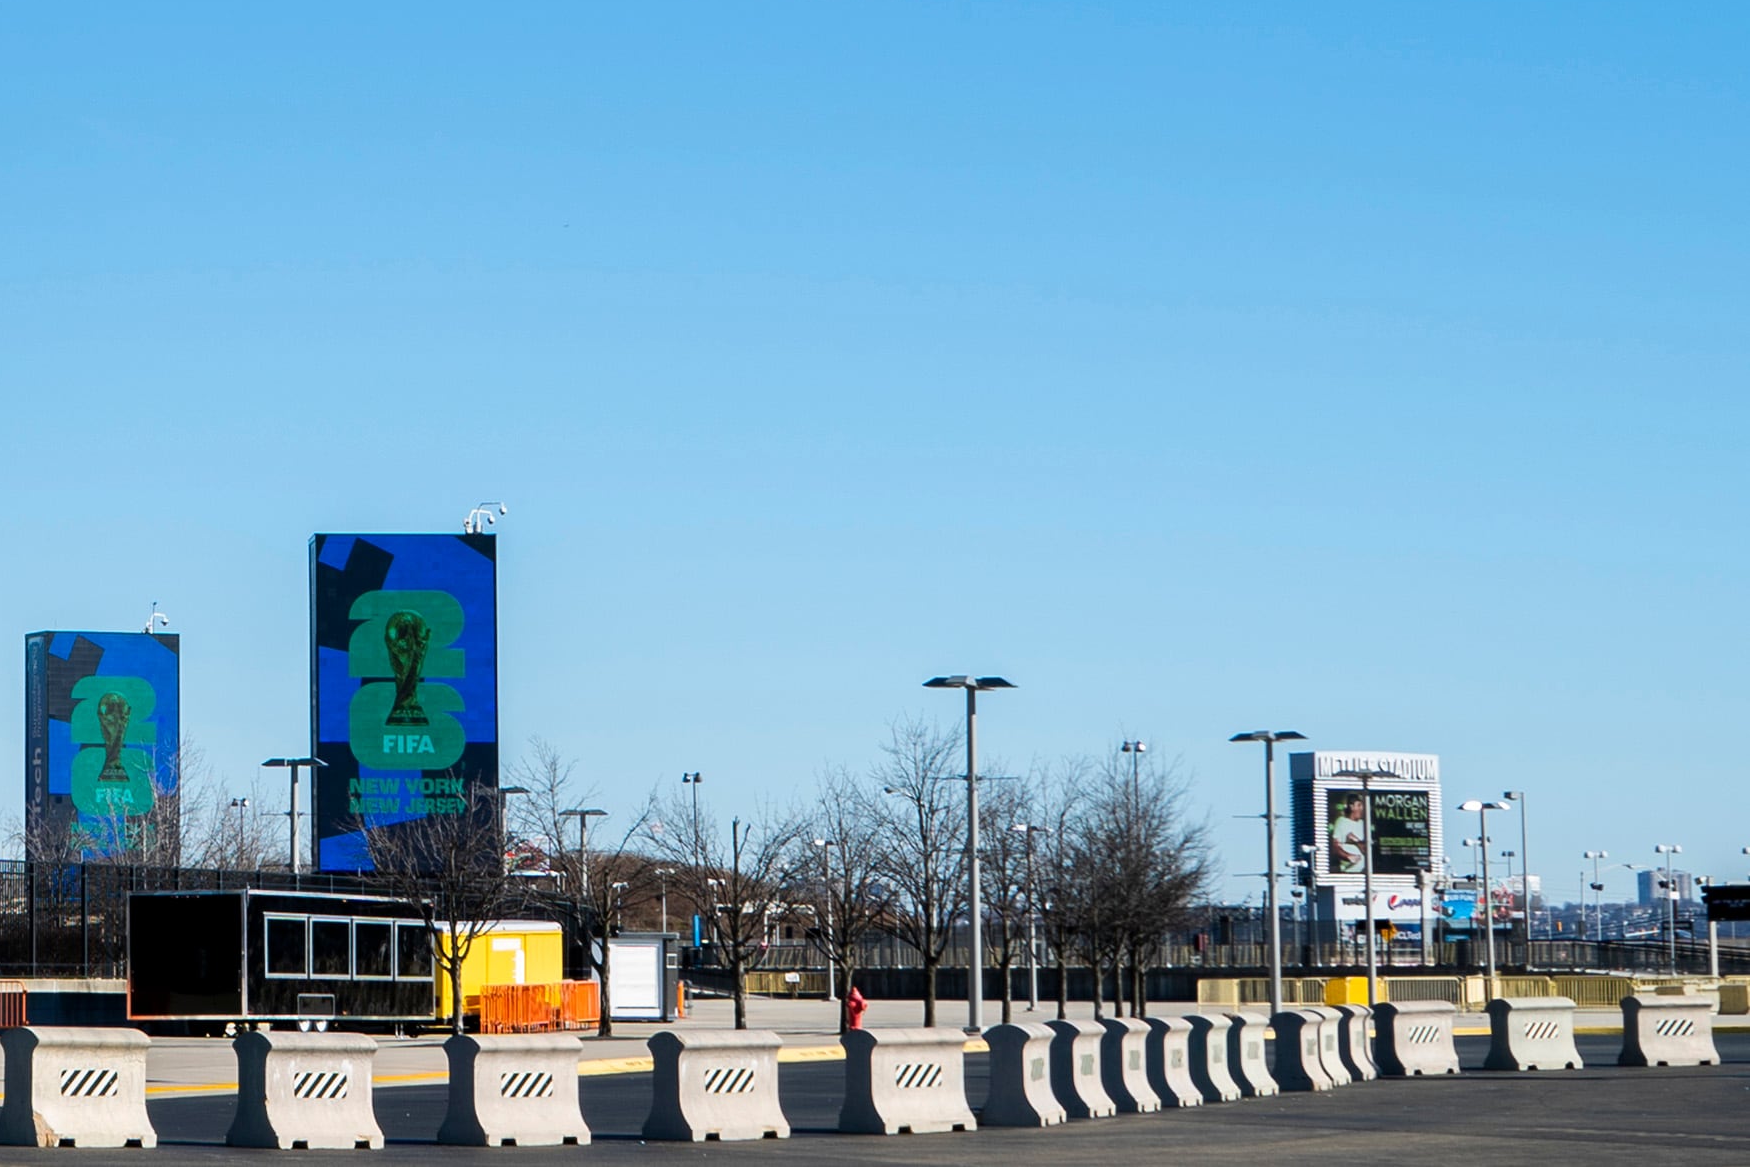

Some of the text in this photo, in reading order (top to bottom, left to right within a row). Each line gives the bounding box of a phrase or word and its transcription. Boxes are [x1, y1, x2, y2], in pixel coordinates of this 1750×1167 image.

[383, 734, 435, 753] FIFA
[1378, 757, 1436, 780] STADIUM
[350, 778, 465, 794] NEW YORK
[349, 798, 467, 814] NEW JERSEY
[1375, 794, 1428, 807] MORGAN
[1375, 808, 1428, 820] WALLEN
